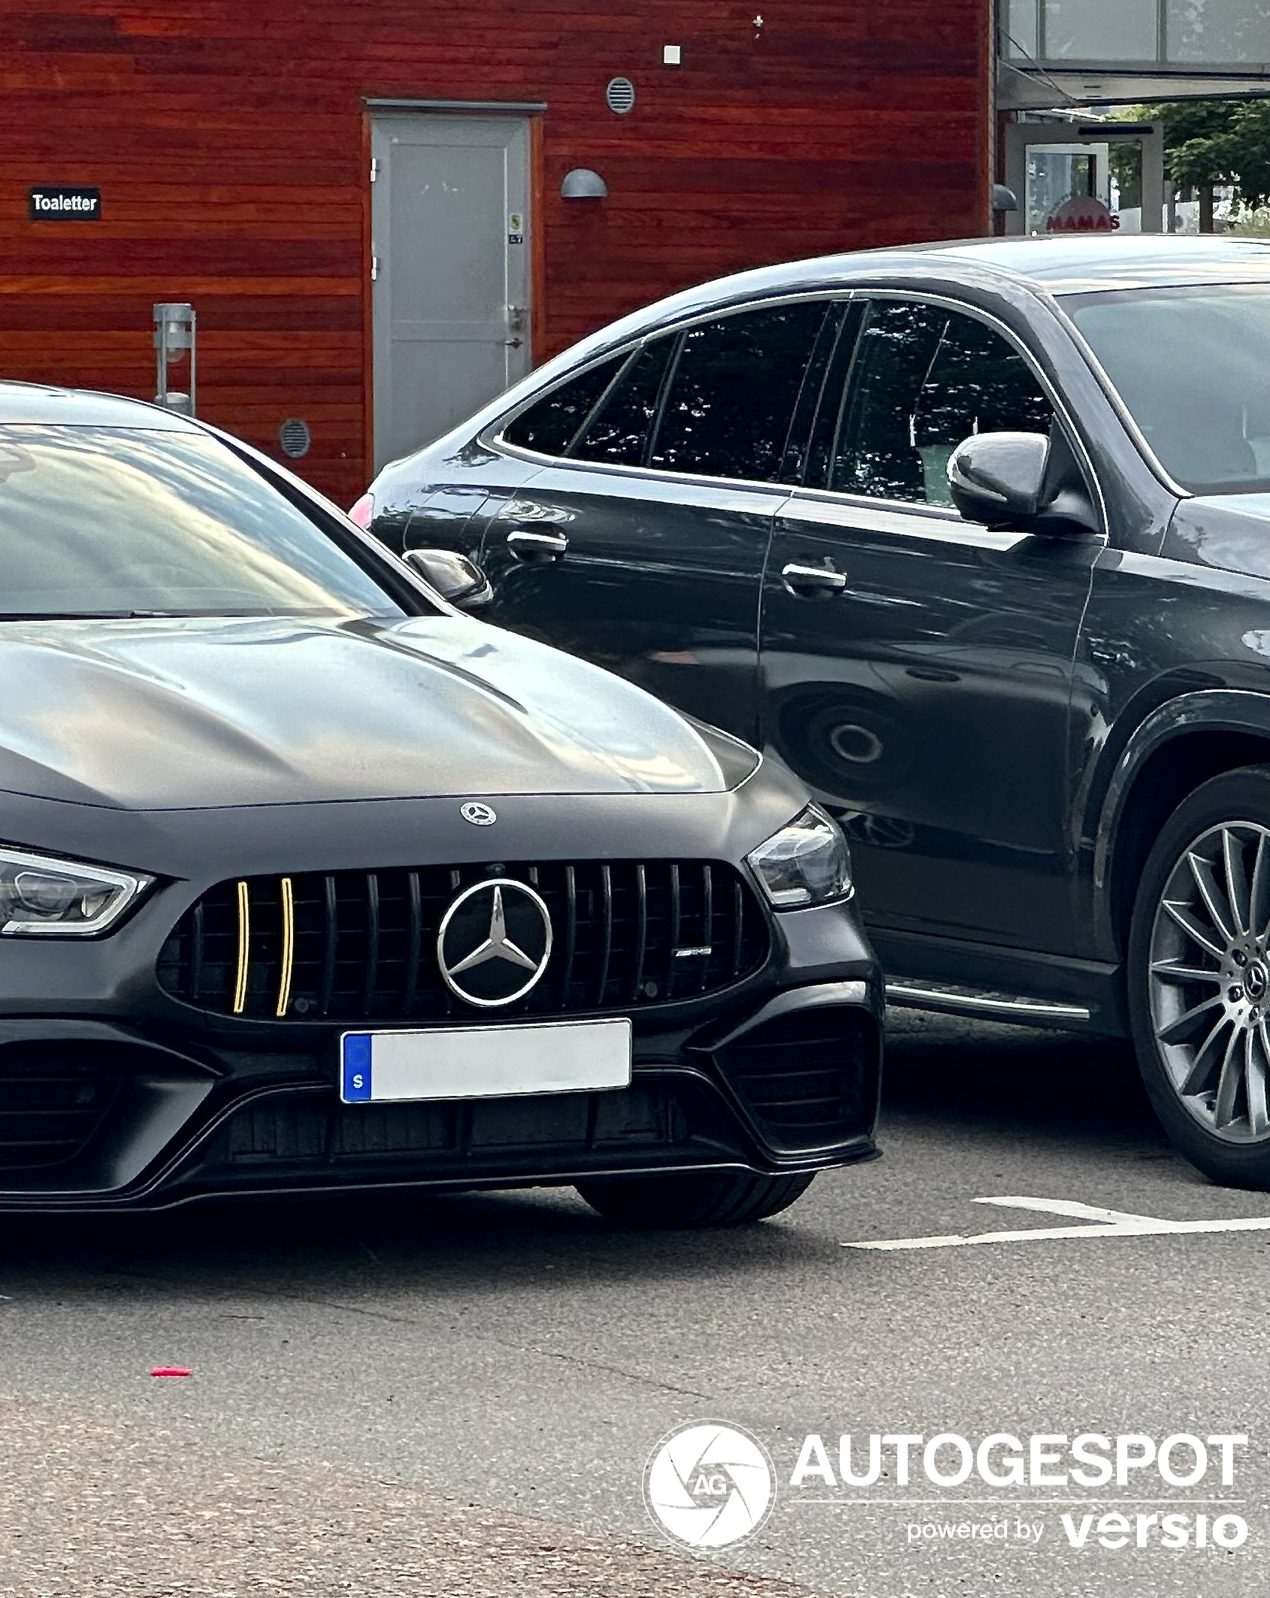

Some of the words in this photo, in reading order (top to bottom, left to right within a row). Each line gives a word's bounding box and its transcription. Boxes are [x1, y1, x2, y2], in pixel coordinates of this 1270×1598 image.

[32, 194, 97, 211] Toaletter
[1046, 215, 1120, 230] MAMAS
[353, 1074, 363, 1089] S
